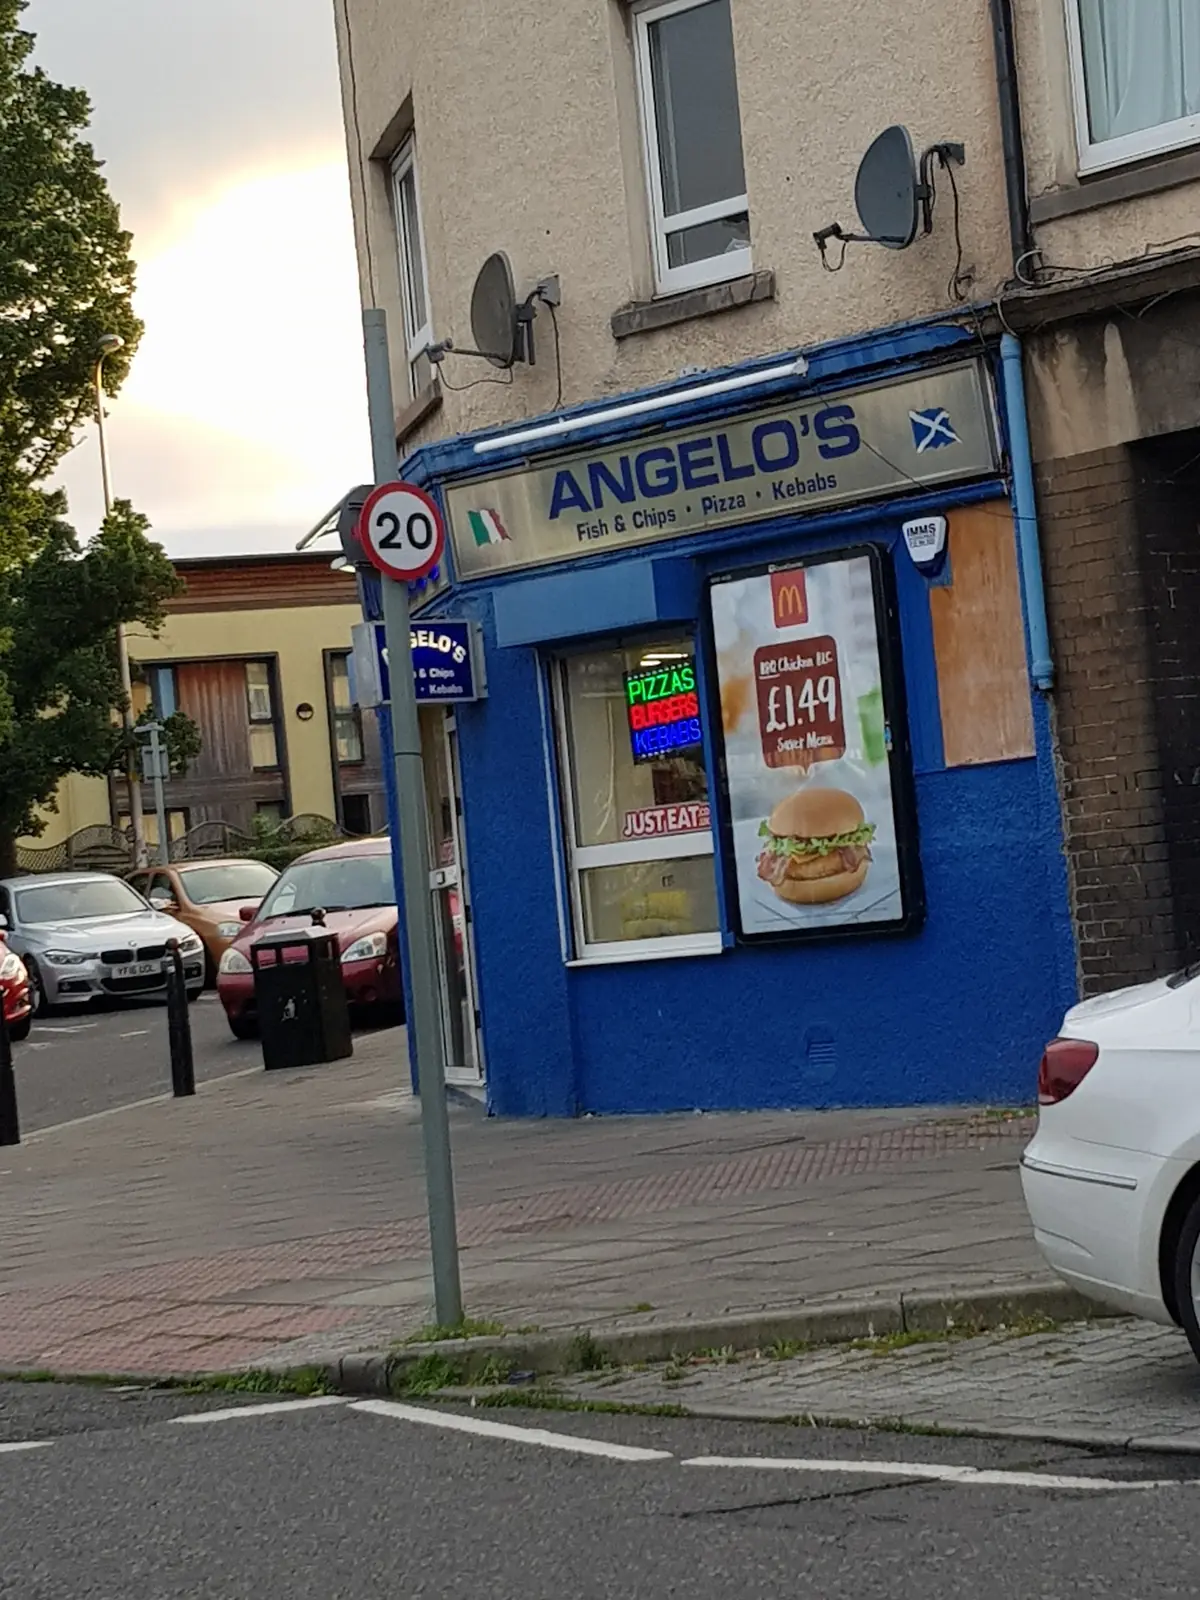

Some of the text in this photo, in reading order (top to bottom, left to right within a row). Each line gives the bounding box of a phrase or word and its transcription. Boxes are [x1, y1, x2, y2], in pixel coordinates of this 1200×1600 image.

[549, 404, 861, 521] ANGELO'S
[576, 472, 837, 542] Fish & Chips Pizza Kebabs
[376, 512, 432, 550] 20
[778, 654, 813, 672] Chicken
[628, 667, 695, 704] PIZZAS
[630, 692, 698, 730] BURGERS
[766, 676, 836, 733] £1.49
[634, 718, 702, 754] KEBABS
[806, 730, 834, 748] Menu
[624, 809, 665, 838] JUST
[662, 805, 699, 834] EAT
